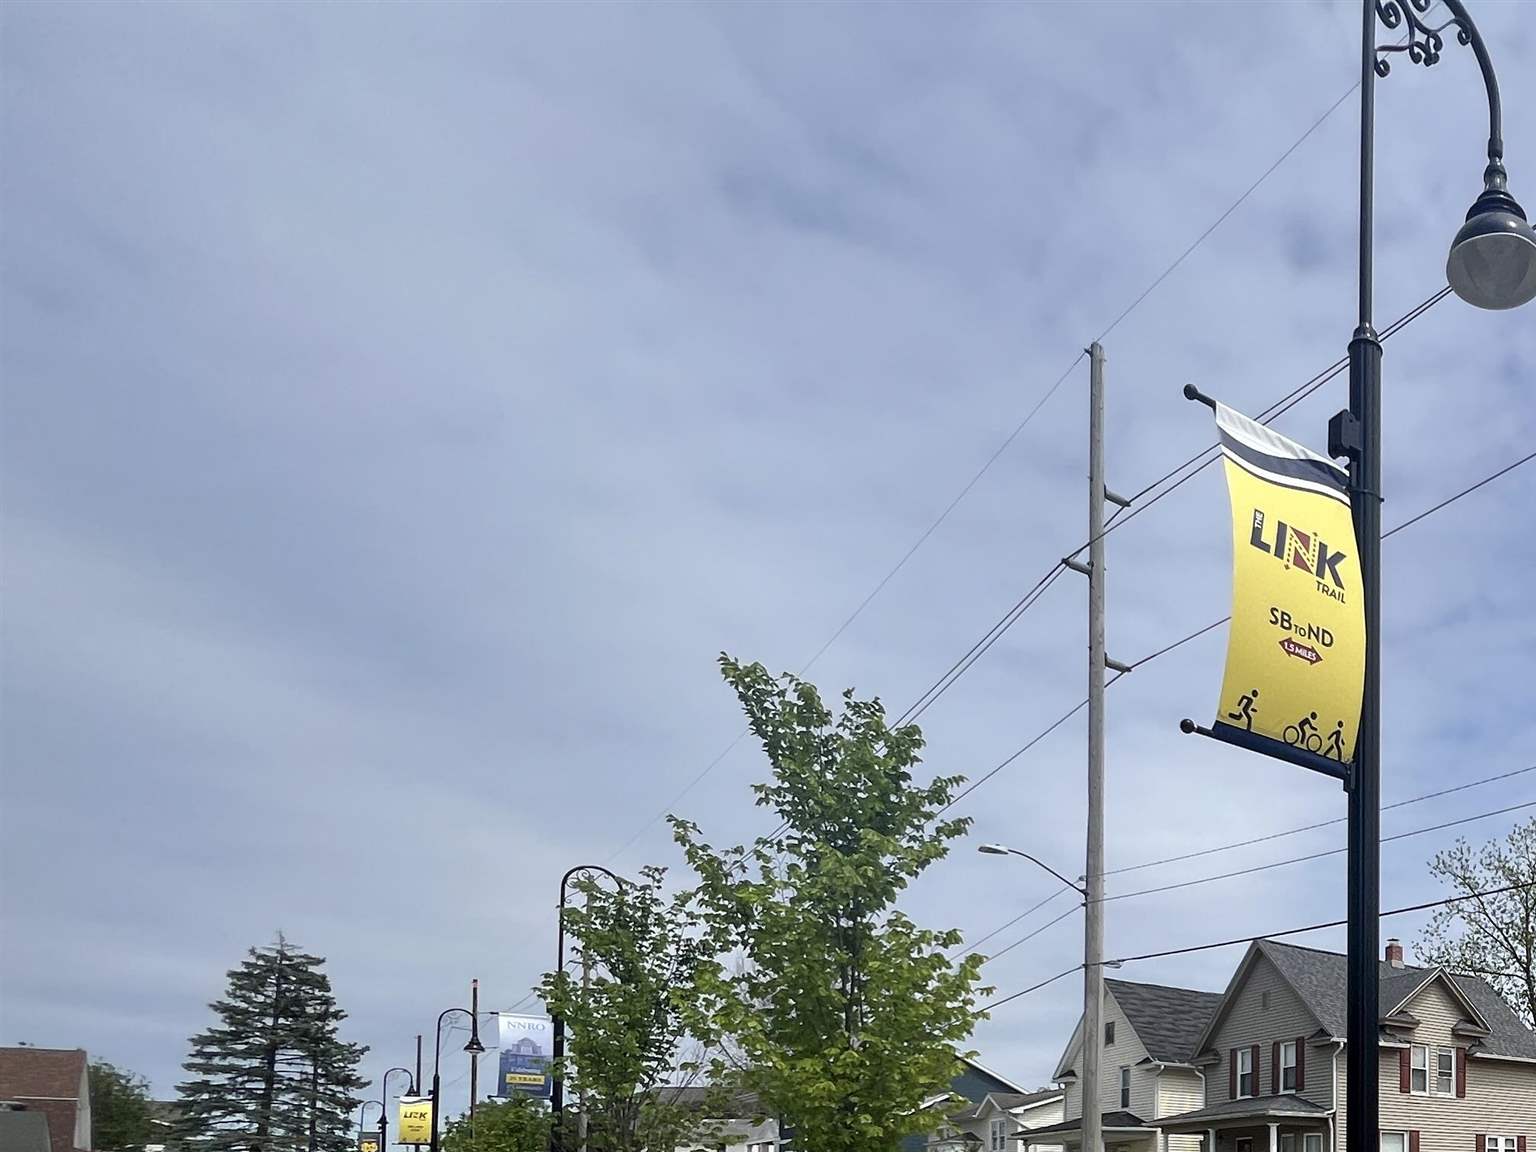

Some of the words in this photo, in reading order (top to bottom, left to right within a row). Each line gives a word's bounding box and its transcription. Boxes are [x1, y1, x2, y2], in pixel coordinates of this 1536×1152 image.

[1254, 510, 1264, 529] THE
[1250, 508, 1347, 591] LINK
[1316, 580, 1346, 604] TRAIL
[1294, 646, 1317, 661] MILES
[507, 1021, 545, 1031] NNRO
